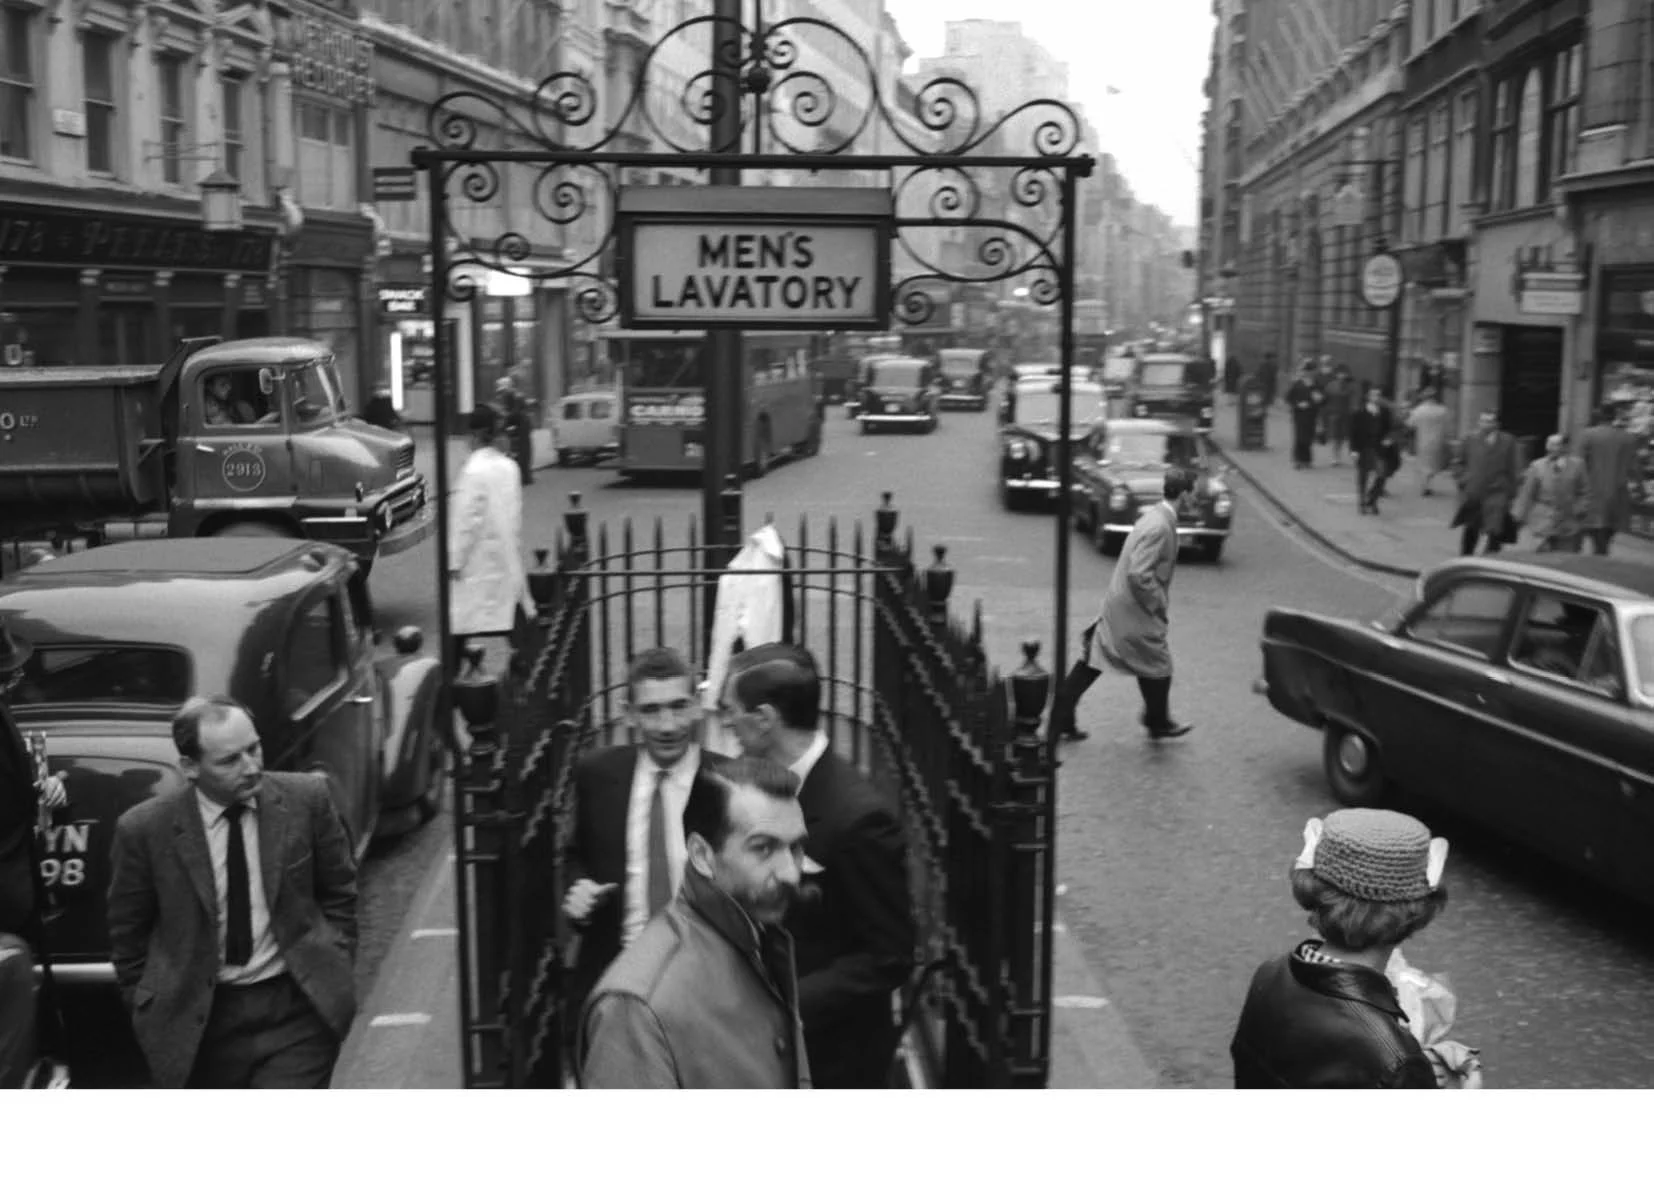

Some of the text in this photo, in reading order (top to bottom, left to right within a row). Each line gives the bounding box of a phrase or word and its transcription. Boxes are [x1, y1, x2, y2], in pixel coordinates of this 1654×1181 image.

[698, 232, 815, 269] MEN'S
[652, 275, 863, 309] LAVATORY
[39, 858, 86, 887] 98
